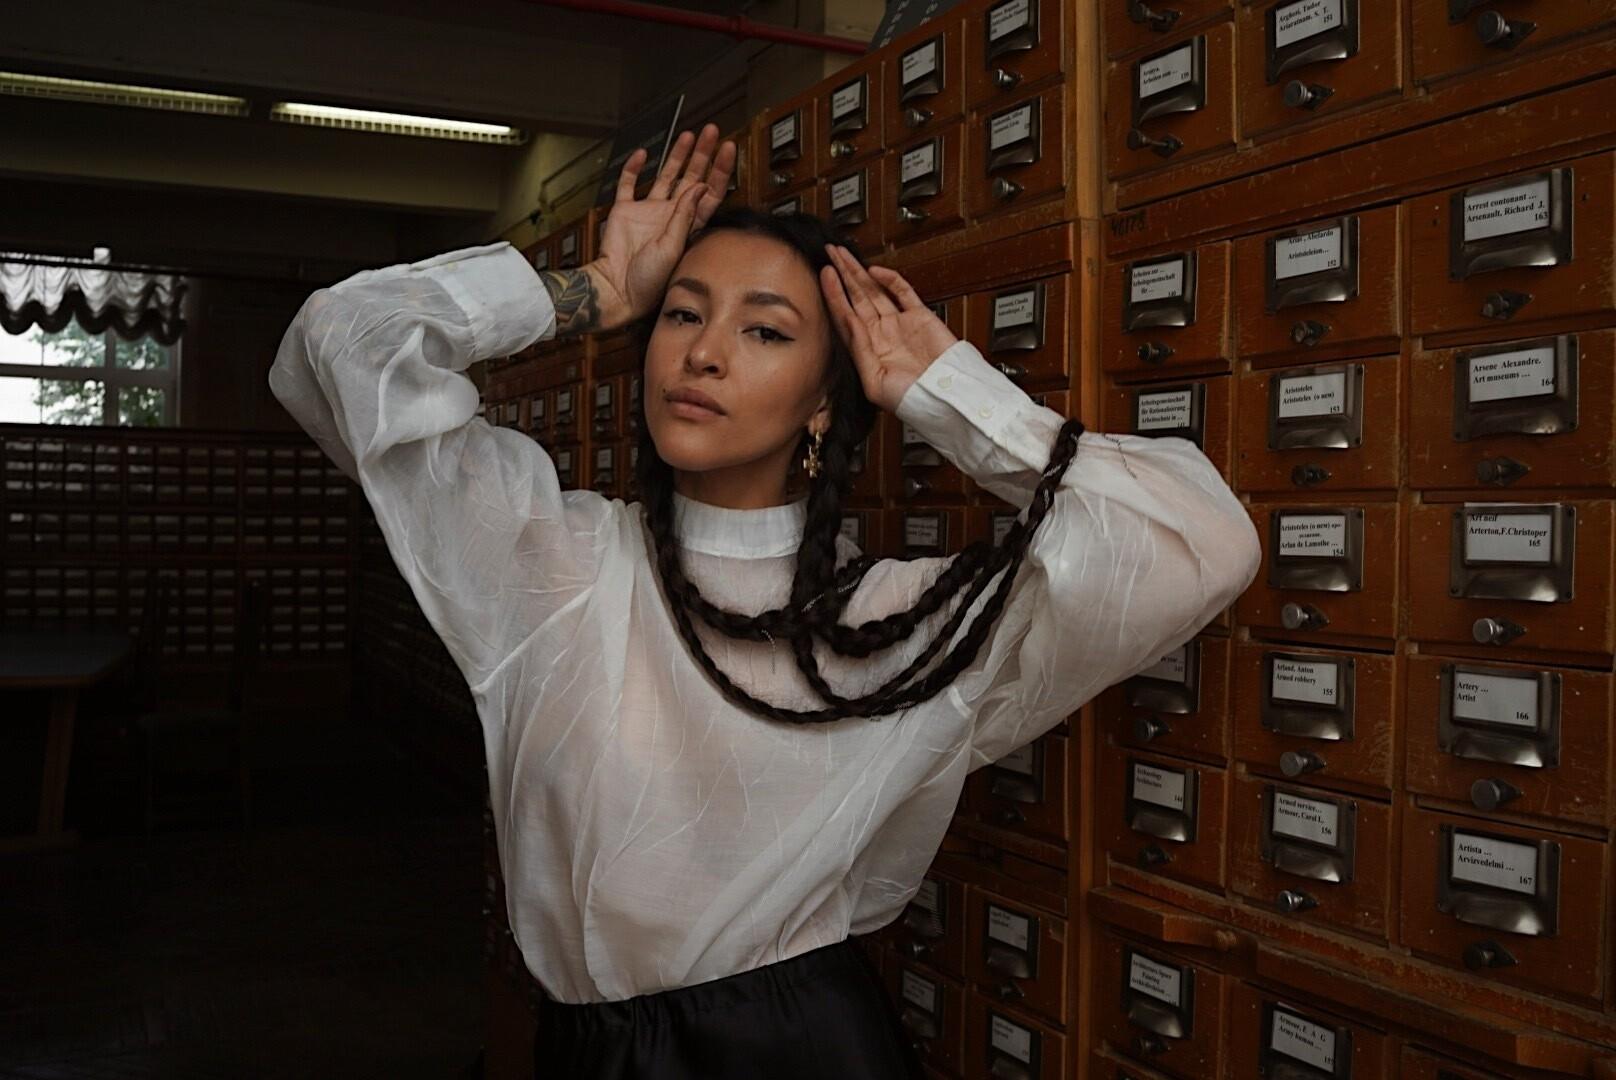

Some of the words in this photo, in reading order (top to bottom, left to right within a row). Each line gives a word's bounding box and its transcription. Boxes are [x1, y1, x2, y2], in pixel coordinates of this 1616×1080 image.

[1303, 1, 1320, 12] Tudor
[1467, 201, 1489, 212] Arrest
[1467, 210, 1503, 223] Arsenault,
[1504, 202, 1534, 216] Richard
[1538, 200, 1545, 209] J.
[1535, 211, 1548, 221] 163
[1327, 259, 1337, 267] 152
[1473, 363, 1498, 373] Arsene
[1473, 375, 1486, 384] Art
[1486, 372, 1519, 382] museums
[1285, 384, 1313, 394] Aristoteles
[1283, 394, 1312, 405] Aristoteles
[1281, 522, 1309, 531] Aristoteles
[1297, 540, 1303, 548] de
[1529, 539, 1541, 547] 165
[1332, 549, 1344, 557] 154
[1276, 673, 1294, 681] Armed
[1294, 676, 1316, 686] robbery
[1323, 688, 1333, 696] 155
[1457, 682, 1480, 693] Artery
[1457, 693, 1476, 702] Artist
[1516, 711, 1529, 720] 166
[1458, 843, 1482, 854] Artista
[1519, 876, 1532, 885] 167
